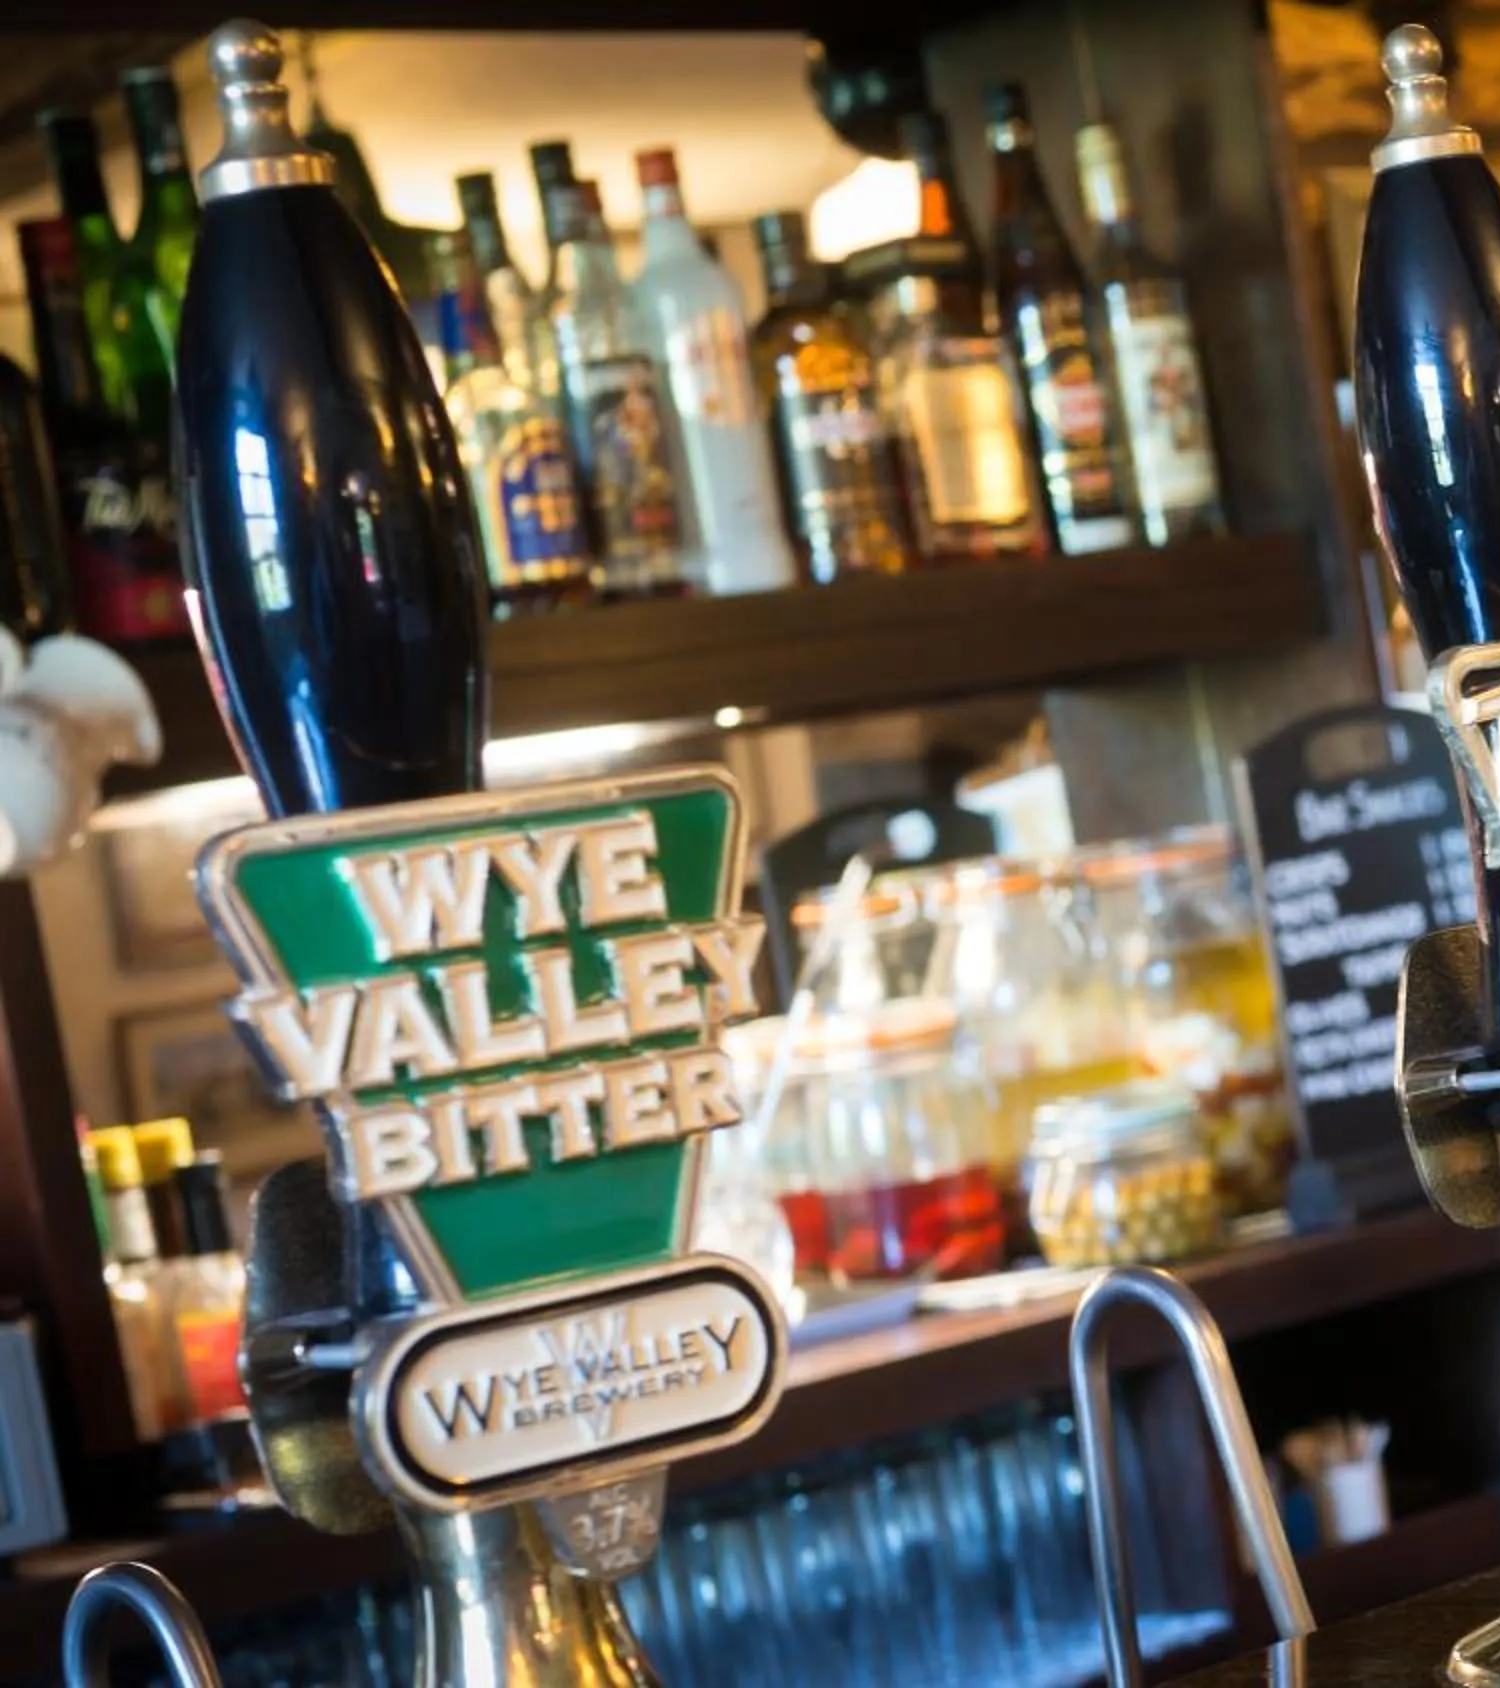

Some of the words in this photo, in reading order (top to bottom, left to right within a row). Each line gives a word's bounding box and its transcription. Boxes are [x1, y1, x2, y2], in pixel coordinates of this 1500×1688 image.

[333, 810, 668, 962] WYE
[230, 914, 767, 1099] VALLEY
[344, 1046, 744, 1200] BITTER
[424, 1363, 560, 1441] WYE
[573, 1315, 744, 1387] VALLEY
[512, 1363, 709, 1429] BREWERY
